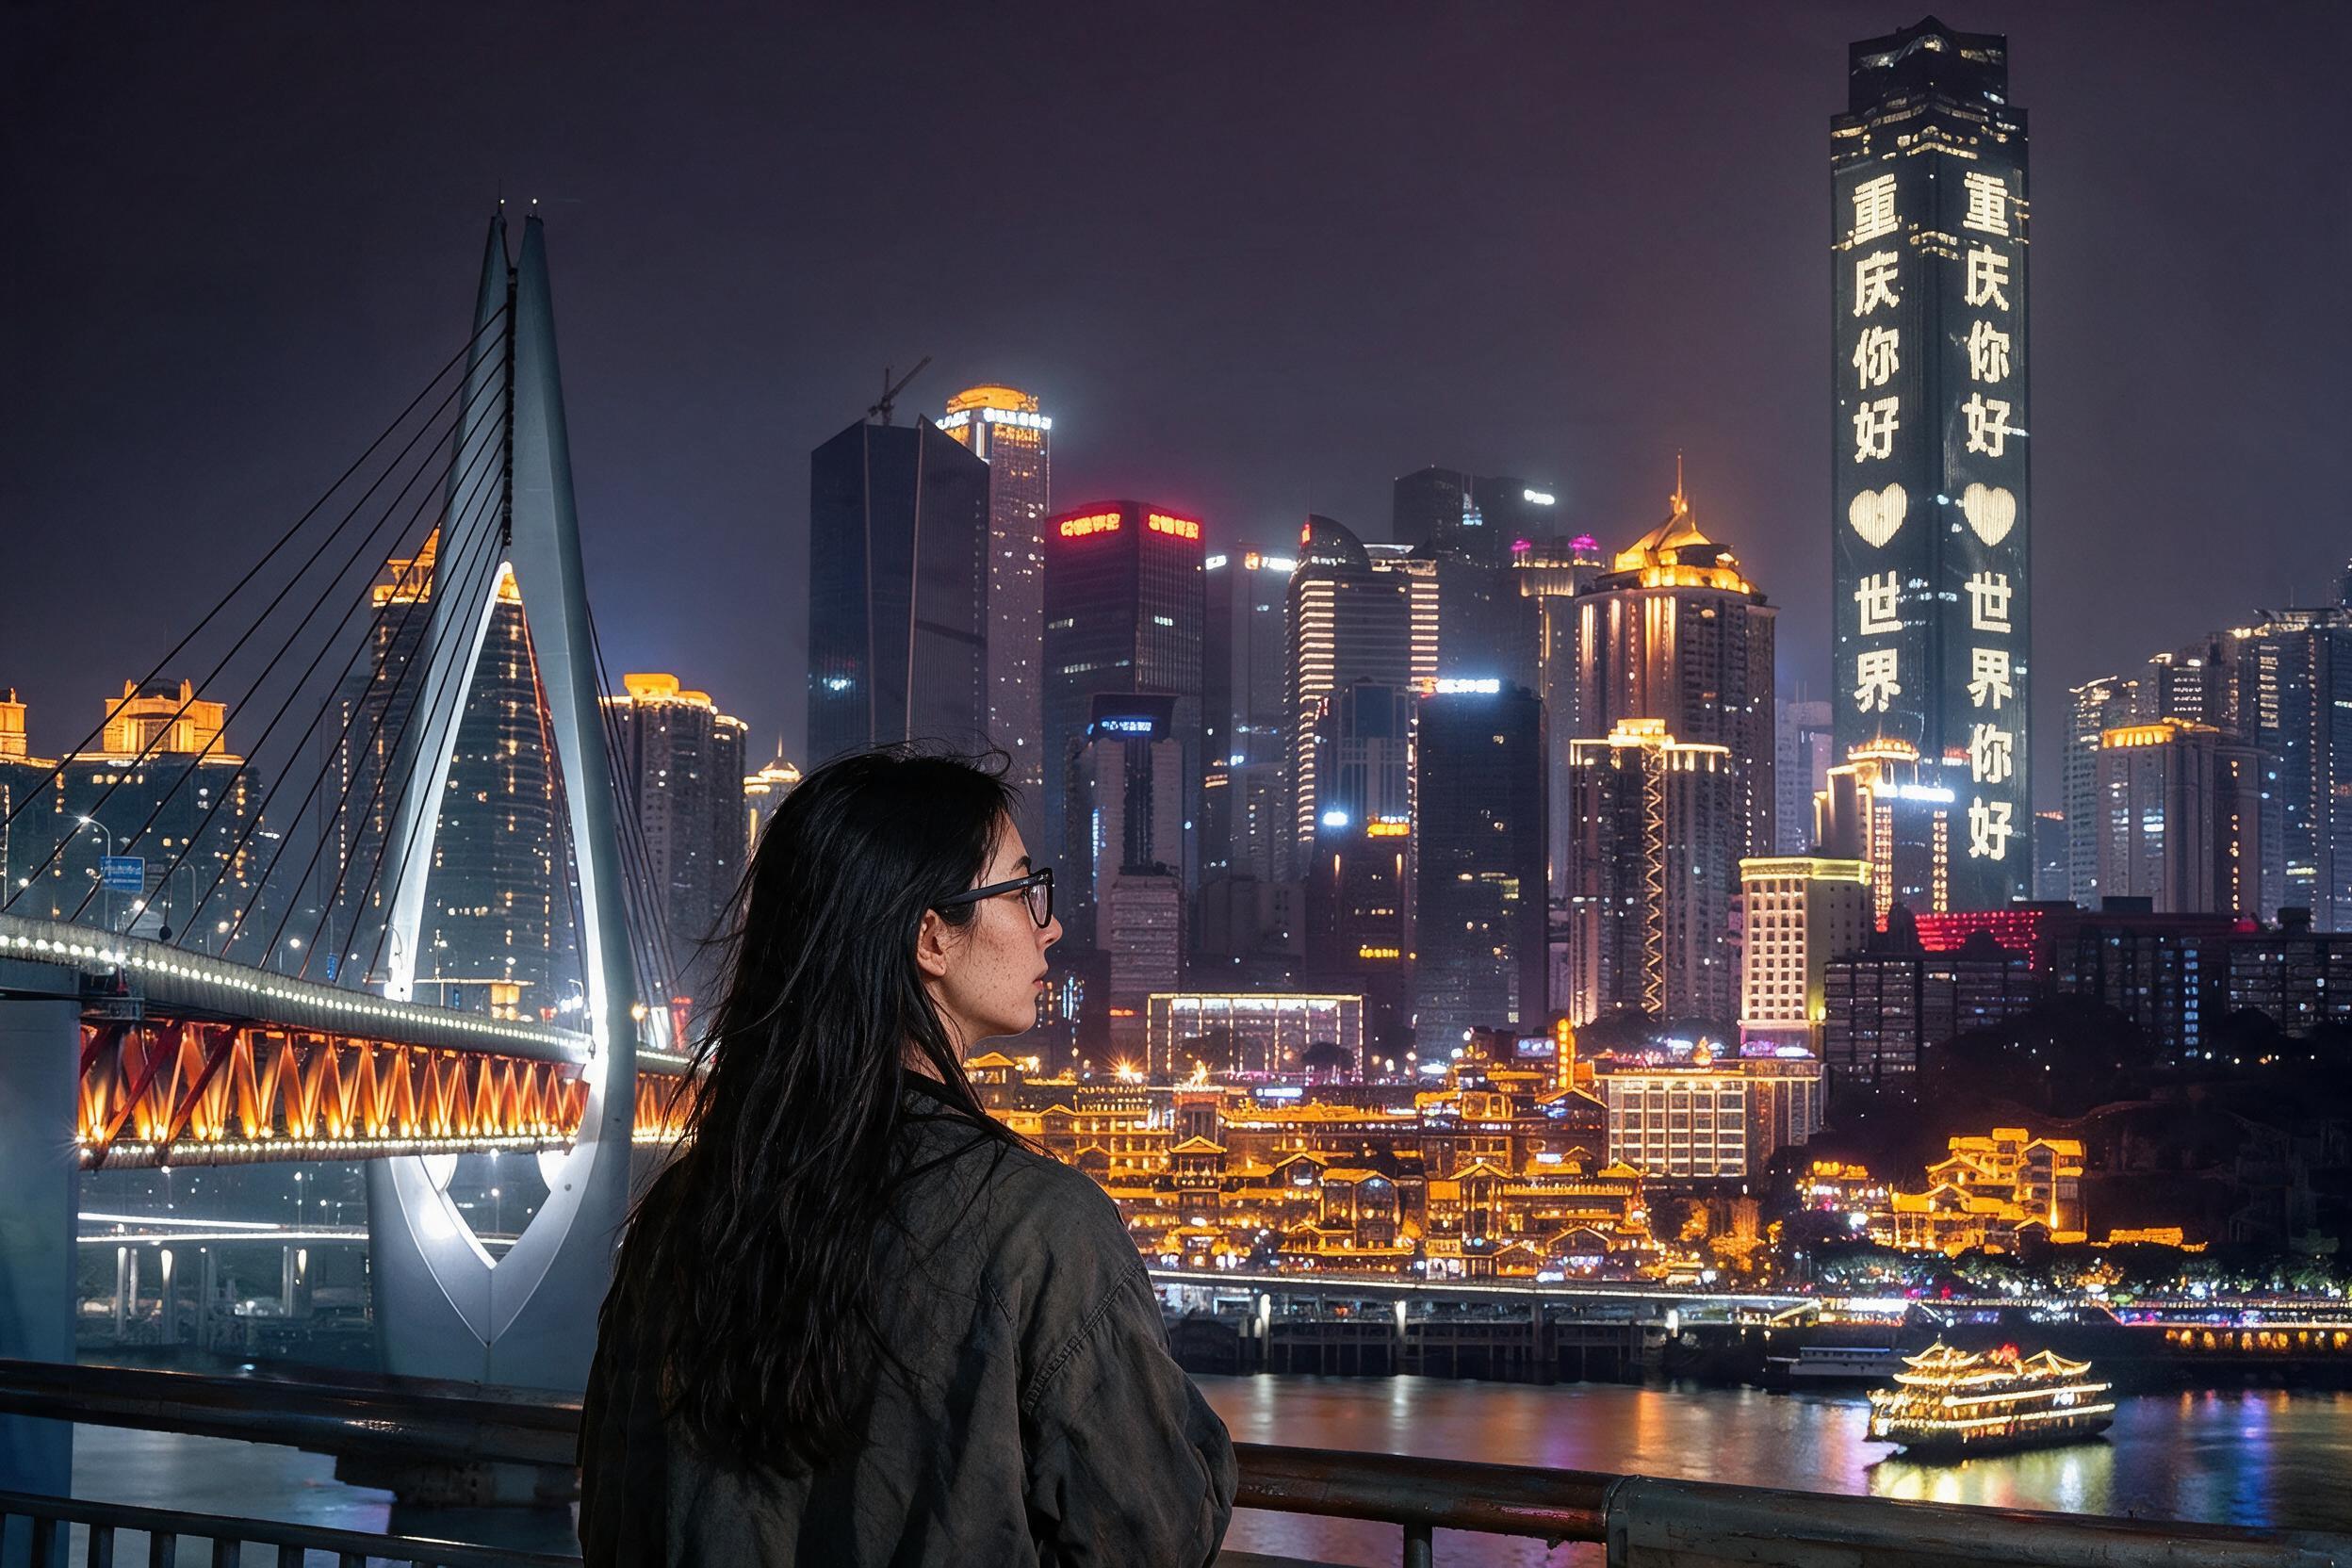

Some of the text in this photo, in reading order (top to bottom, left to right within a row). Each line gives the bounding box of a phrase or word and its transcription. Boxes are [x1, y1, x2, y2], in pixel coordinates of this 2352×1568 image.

[1852, 172, 1903, 713] 重庆你好 世界
[1962, 171, 2014, 861] 重庆你好 世界你好
